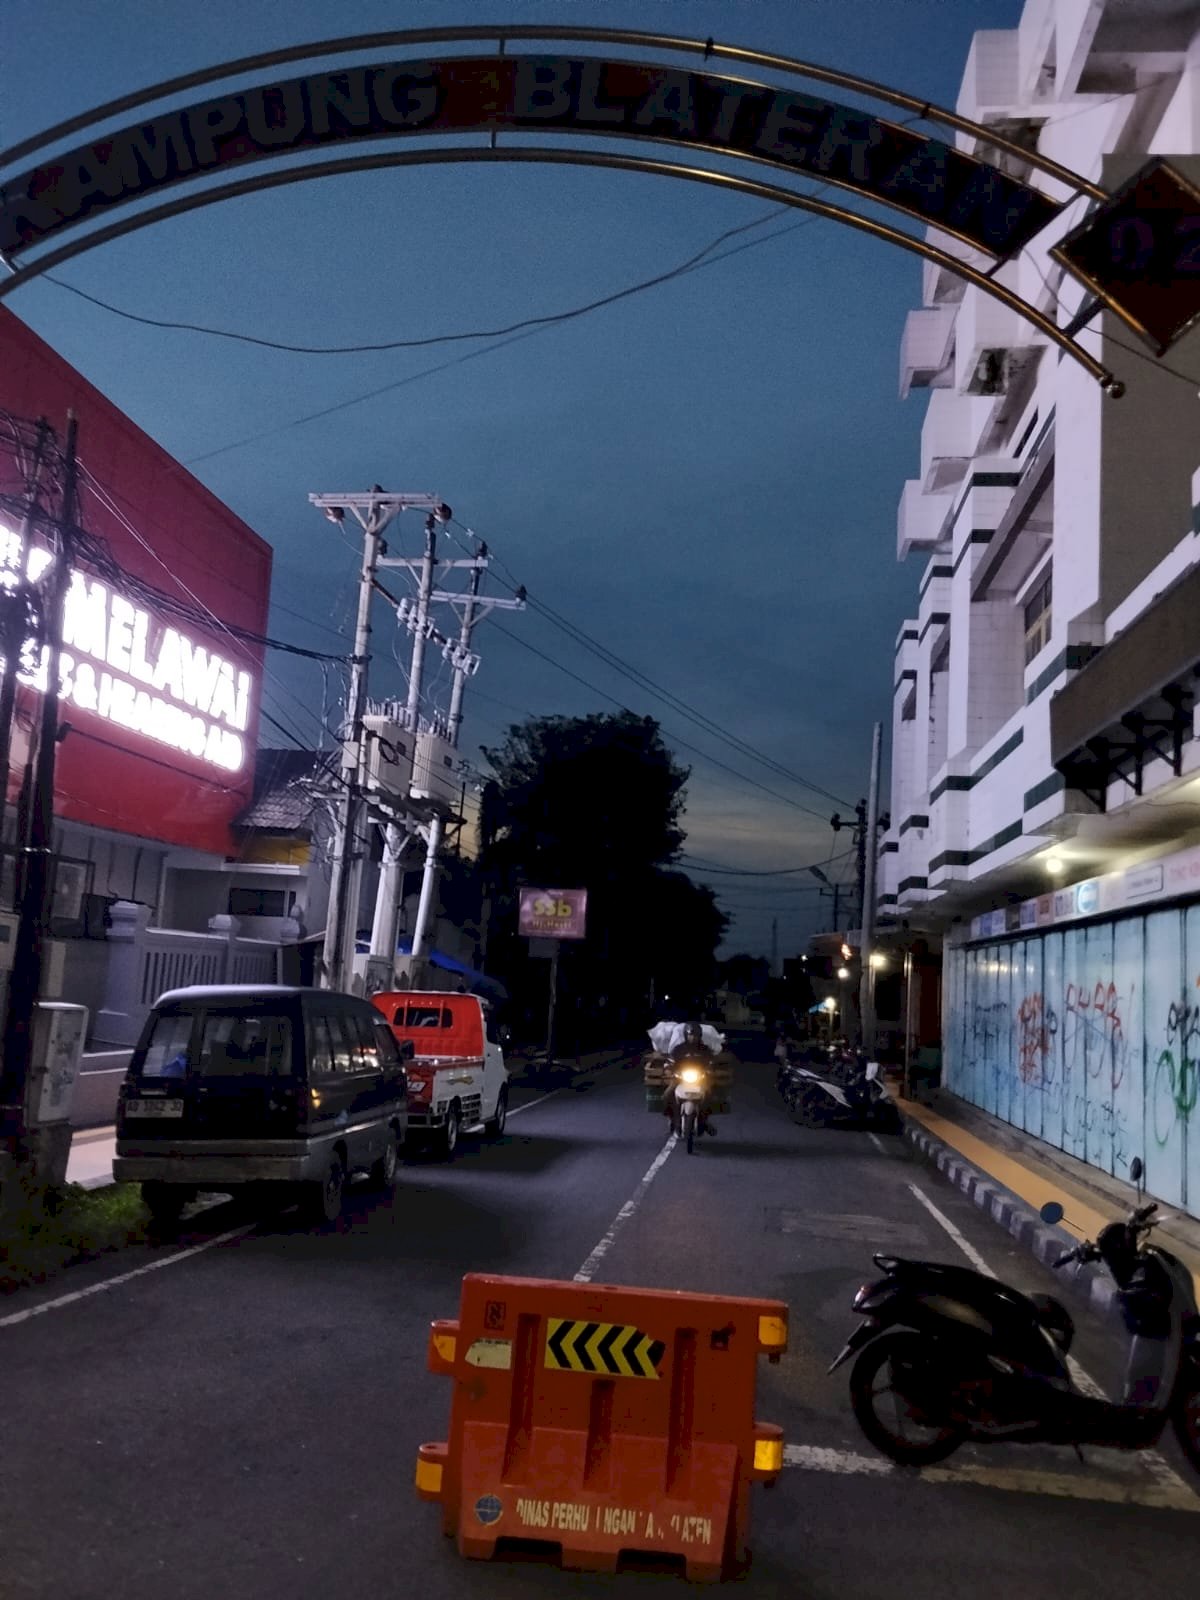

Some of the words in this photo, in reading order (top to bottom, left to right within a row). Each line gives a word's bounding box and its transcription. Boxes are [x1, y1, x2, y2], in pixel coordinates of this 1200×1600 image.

[2, 66, 438, 250] KAMPUNG
[513, 60, 1029, 246] BLATERAN
[62, 568, 252, 731] MELAWAI
